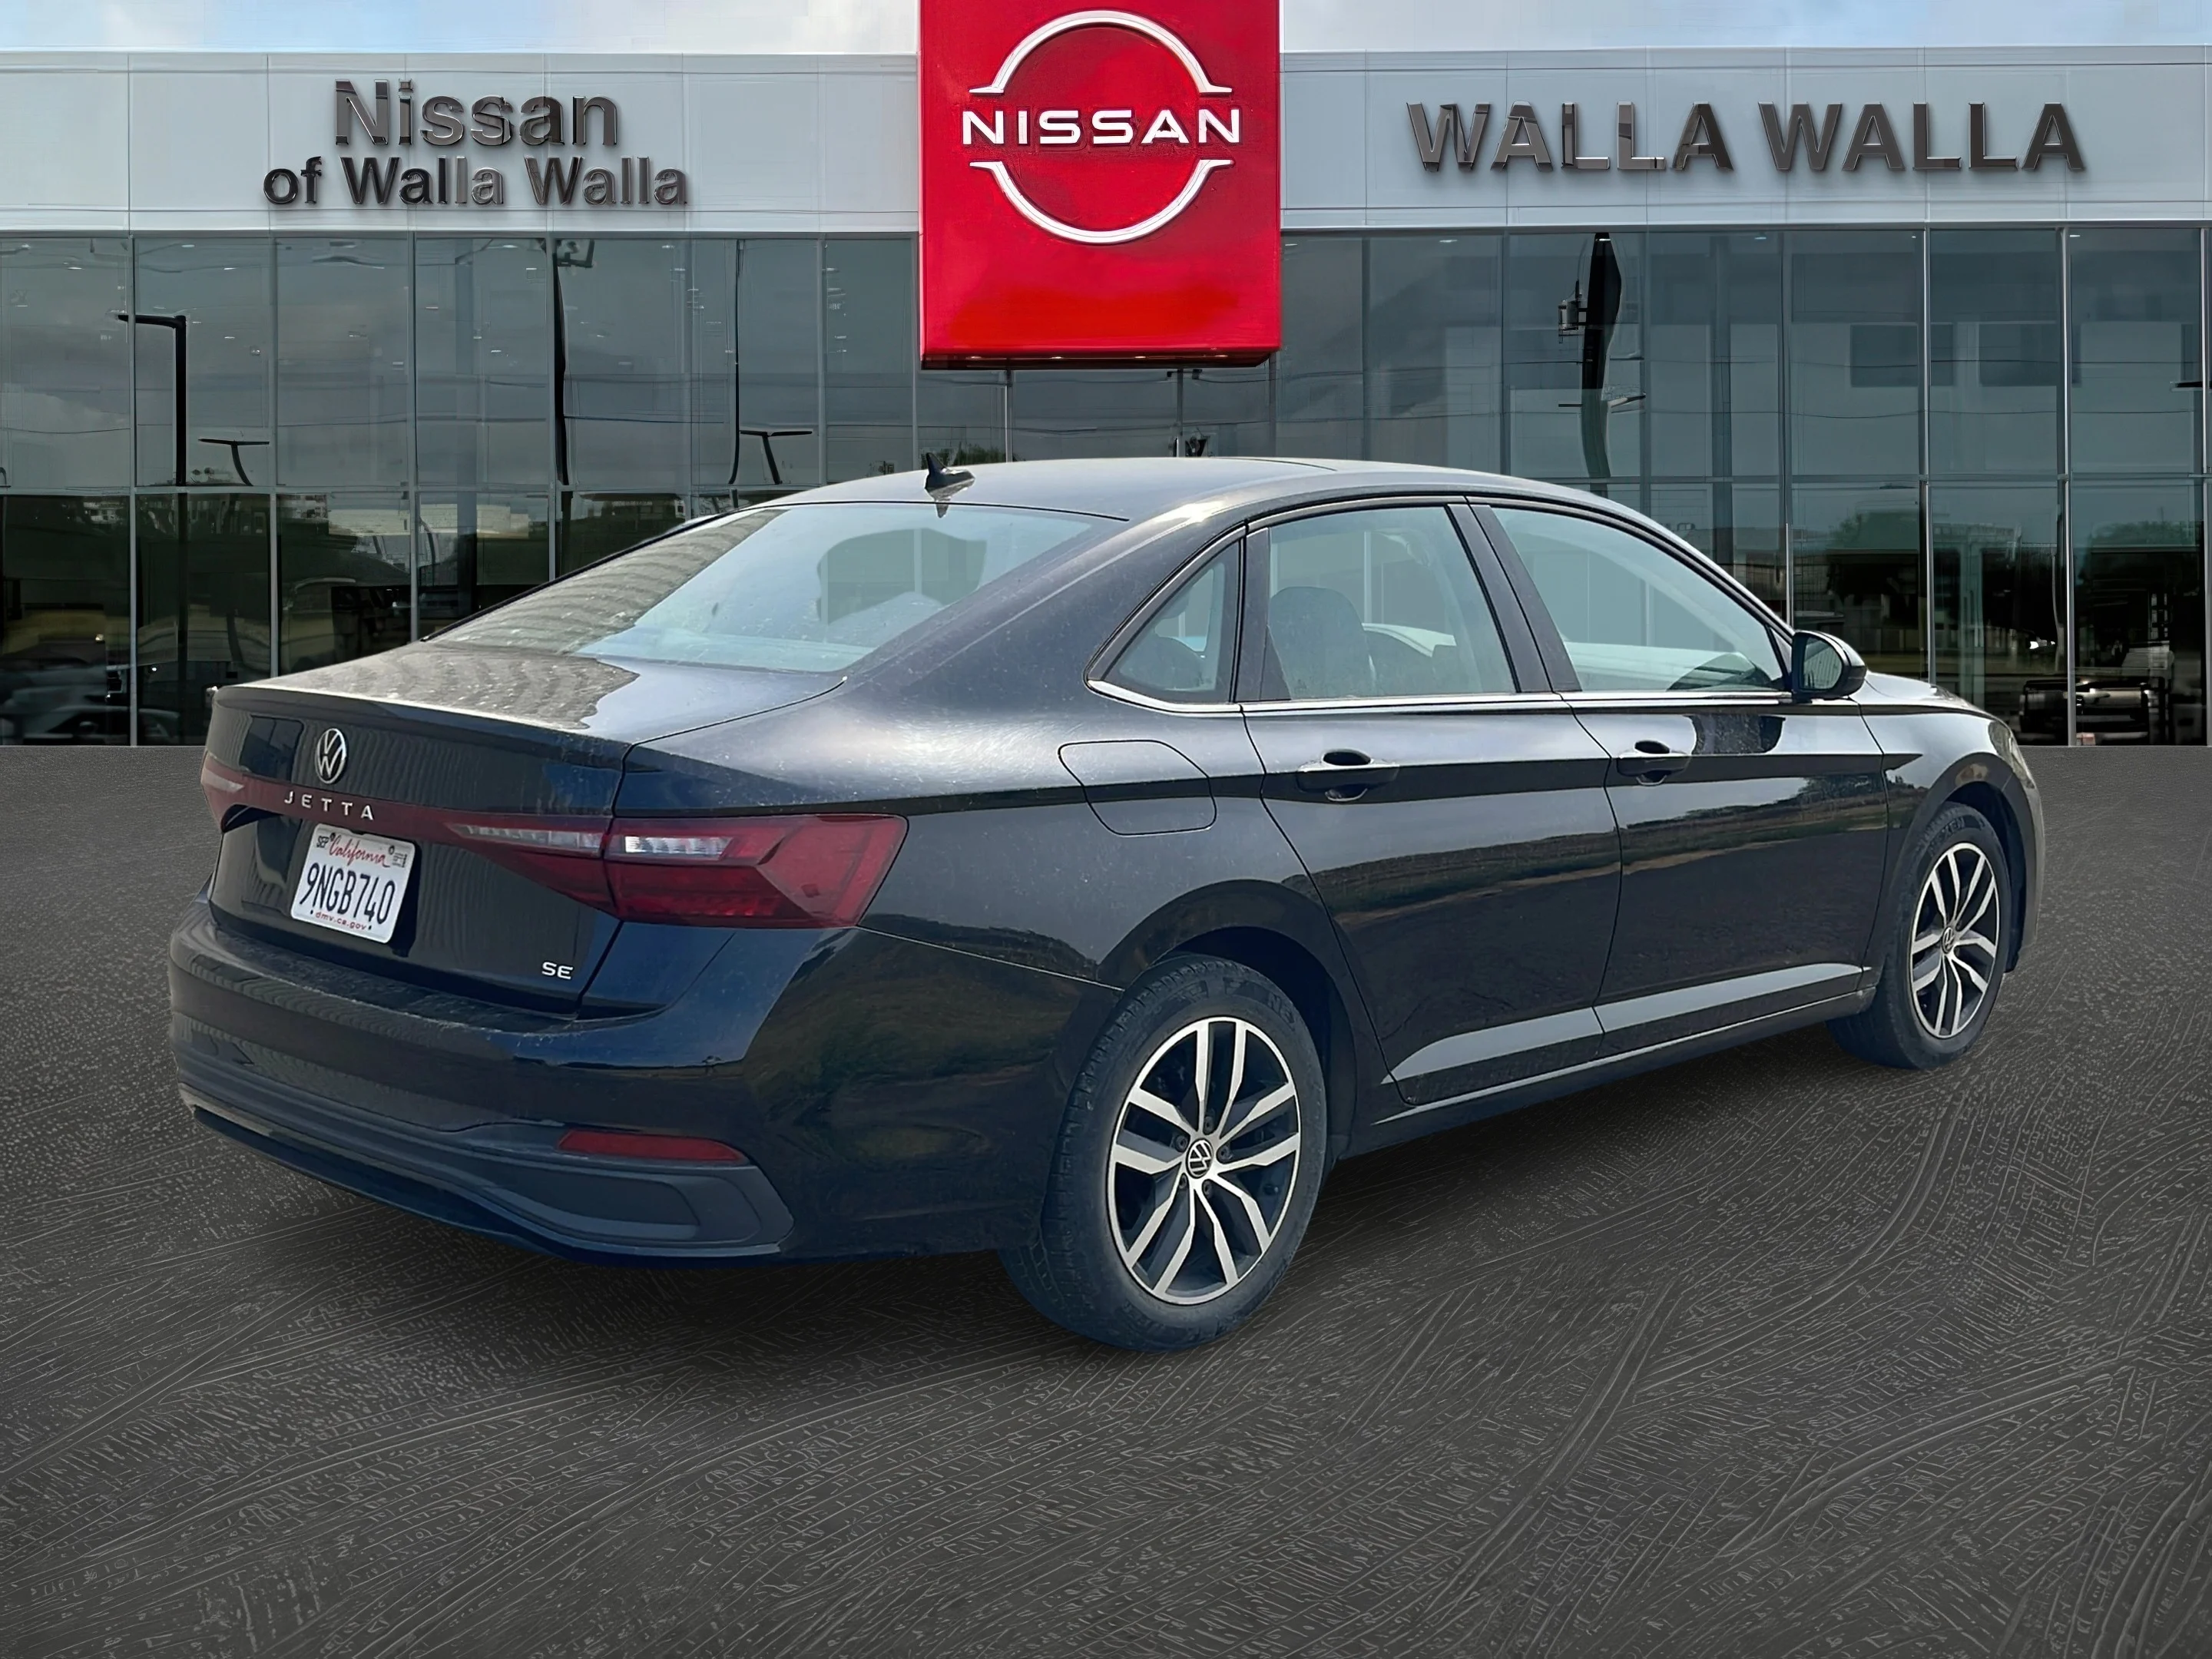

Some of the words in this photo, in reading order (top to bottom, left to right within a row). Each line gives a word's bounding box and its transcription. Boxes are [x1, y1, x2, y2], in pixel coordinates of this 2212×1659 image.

[334, 78, 618, 147] Nissan
[962, 109, 1240, 144] NISSAN
[1406, 100, 1734, 171] WALLA
[1757, 101, 2085, 171] WALLA
[263, 155, 323, 204] of
[339, 155, 505, 205] Walla
[524, 155, 689, 205] Walla
[284, 791, 374, 820] JETTA
[328, 833, 390, 869] California
[299, 862, 396, 925] 9NGB740
[315, 911, 367, 931] dmv.ca.gov
[541, 961, 574, 980] SE
